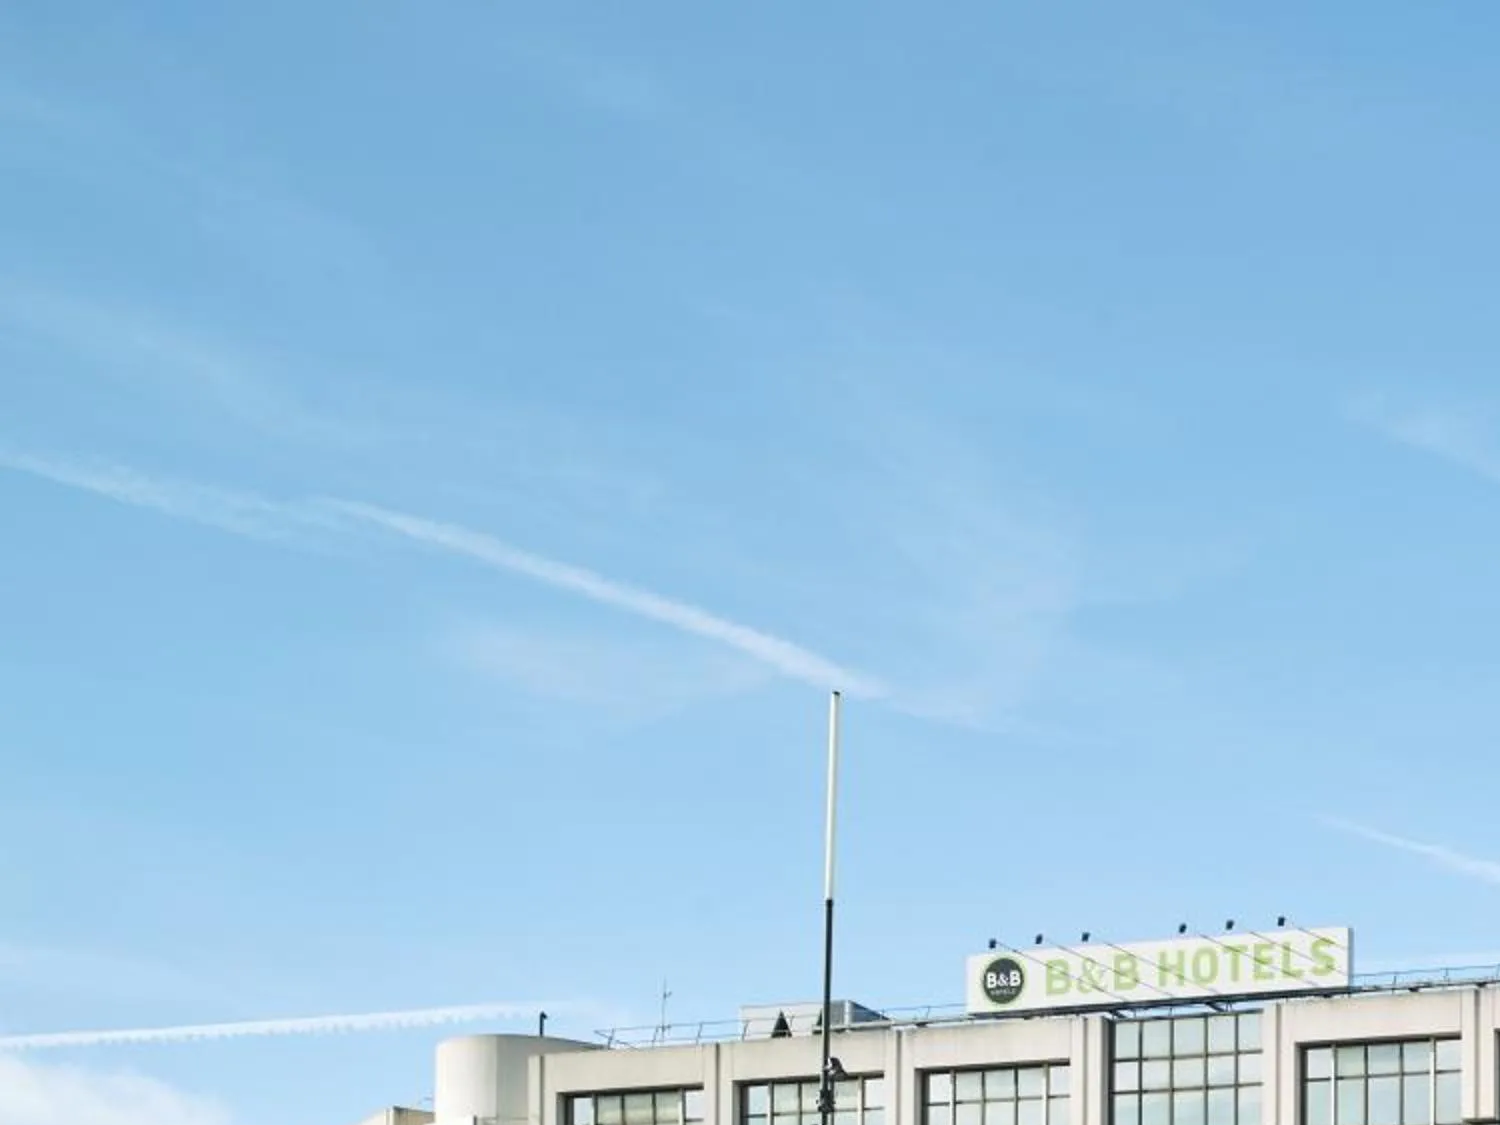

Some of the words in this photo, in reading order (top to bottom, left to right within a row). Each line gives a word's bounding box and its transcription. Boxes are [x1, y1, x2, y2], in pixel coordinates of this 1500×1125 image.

[985, 971, 1021, 987] B&B
[1046, 952, 1140, 995] B&B
[1157, 937, 1337, 987] HOTELS
